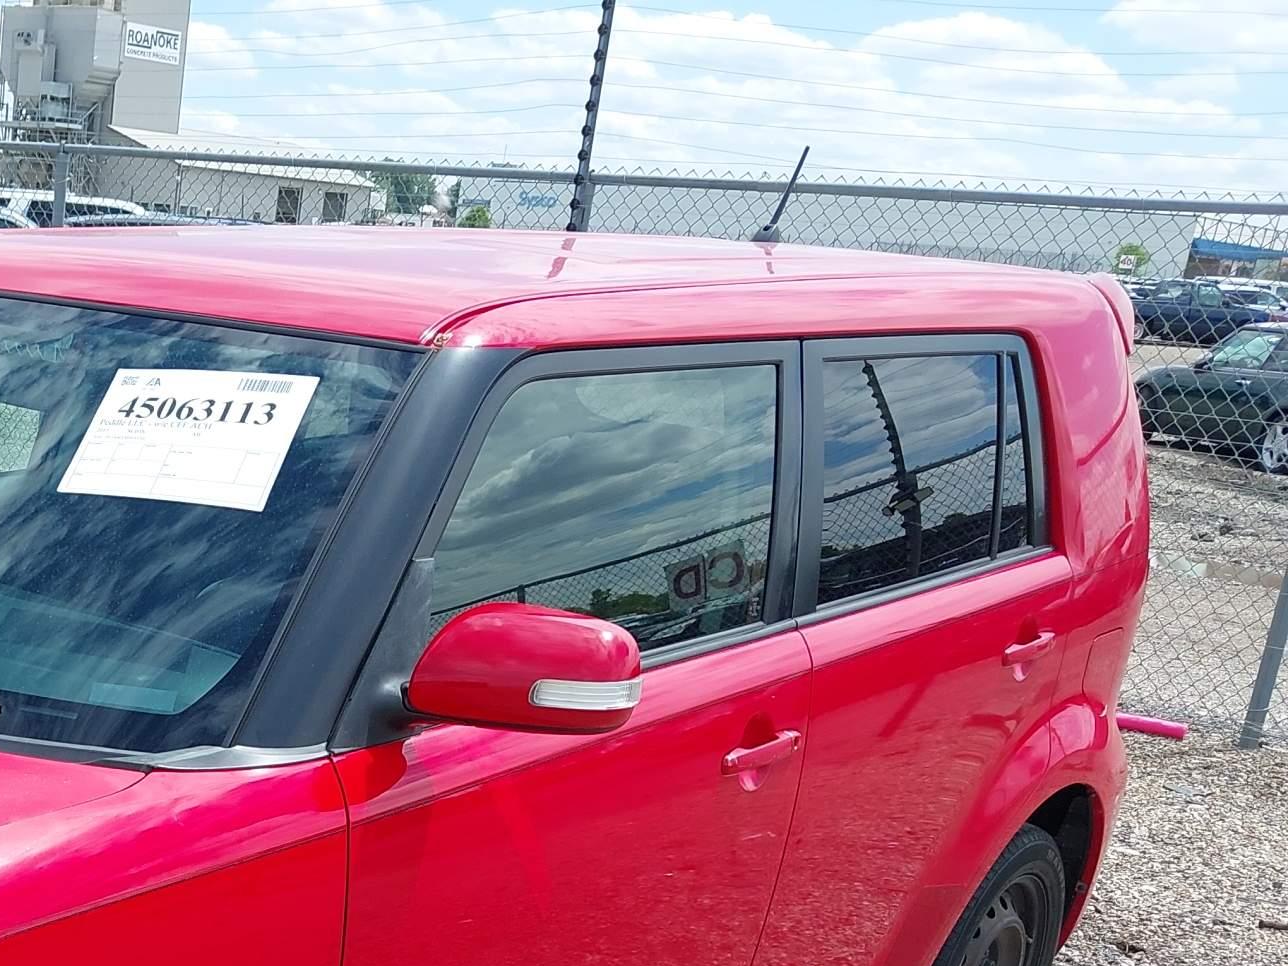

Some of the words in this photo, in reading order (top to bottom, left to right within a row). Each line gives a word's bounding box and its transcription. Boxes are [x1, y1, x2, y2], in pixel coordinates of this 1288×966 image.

[128, 29, 179, 50] ROANOKE
[127, 47, 152, 57] CONCRETE
[118, 396, 277, 426] 45063113
